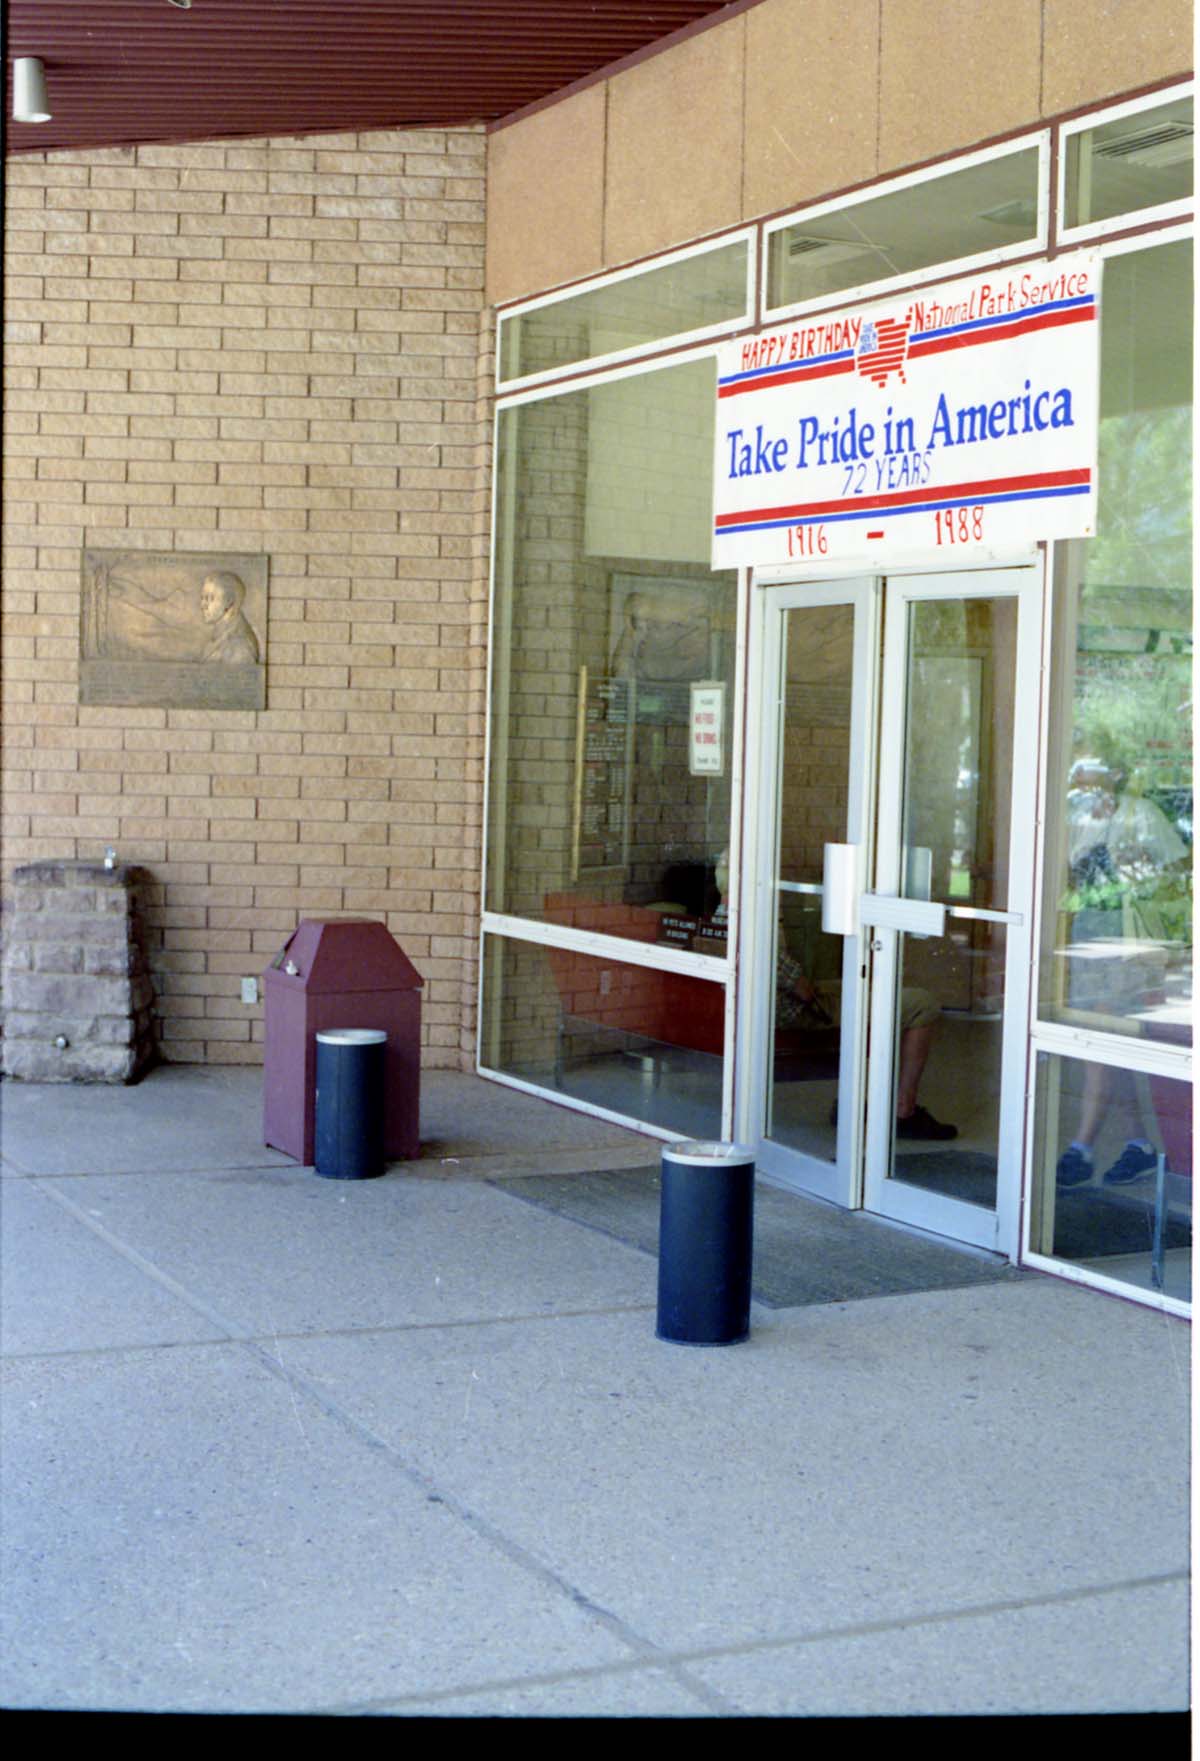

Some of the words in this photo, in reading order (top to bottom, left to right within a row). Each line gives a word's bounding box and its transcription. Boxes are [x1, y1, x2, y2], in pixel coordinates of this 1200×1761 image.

[741, 334, 787, 371] HAPPY
[789, 316, 862, 361] BIRTHDAY
[914, 290, 975, 332] National
[978, 281, 1017, 317] Park
[1020, 272, 1088, 308] Service
[726, 425, 788, 479] Take
[796, 408, 876, 469] Pride
[883, 406, 917, 456] in
[926, 379, 1075, 450] America
[841, 462, 867, 496] 72
[875, 450, 932, 491] YEARS
[788, 525, 828, 557] 1916
[935, 506, 984, 545] 1988
